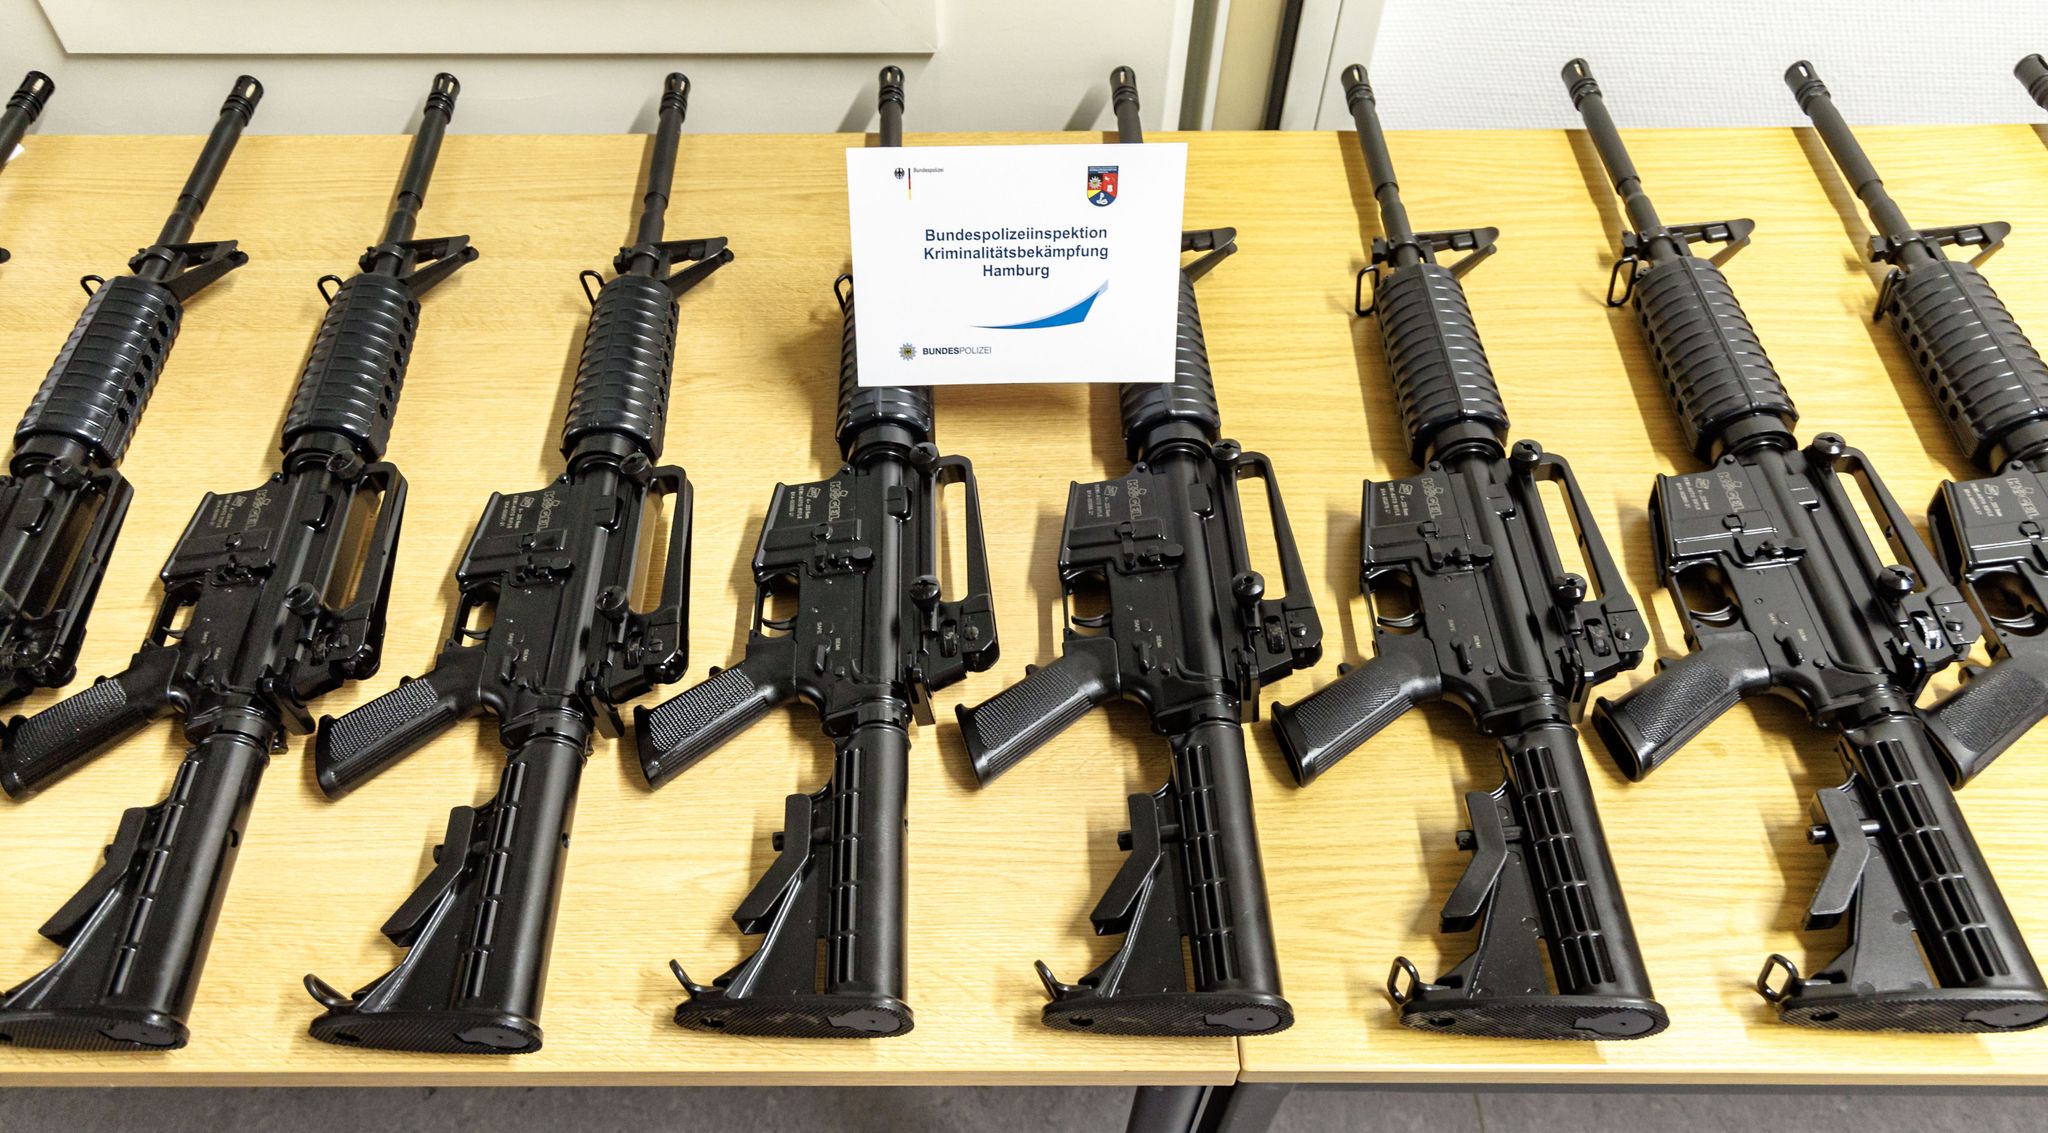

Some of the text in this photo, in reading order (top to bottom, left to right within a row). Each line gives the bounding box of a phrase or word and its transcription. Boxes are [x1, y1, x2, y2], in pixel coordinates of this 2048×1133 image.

[926, 227, 1106, 243] Bundespolizeiinspektion
[925, 245, 1108, 260] Kriminalitätsbekämpfung
[984, 264, 1049, 278] Hamburg
[922, 346, 992, 356] BUNDESPOLIZEI
